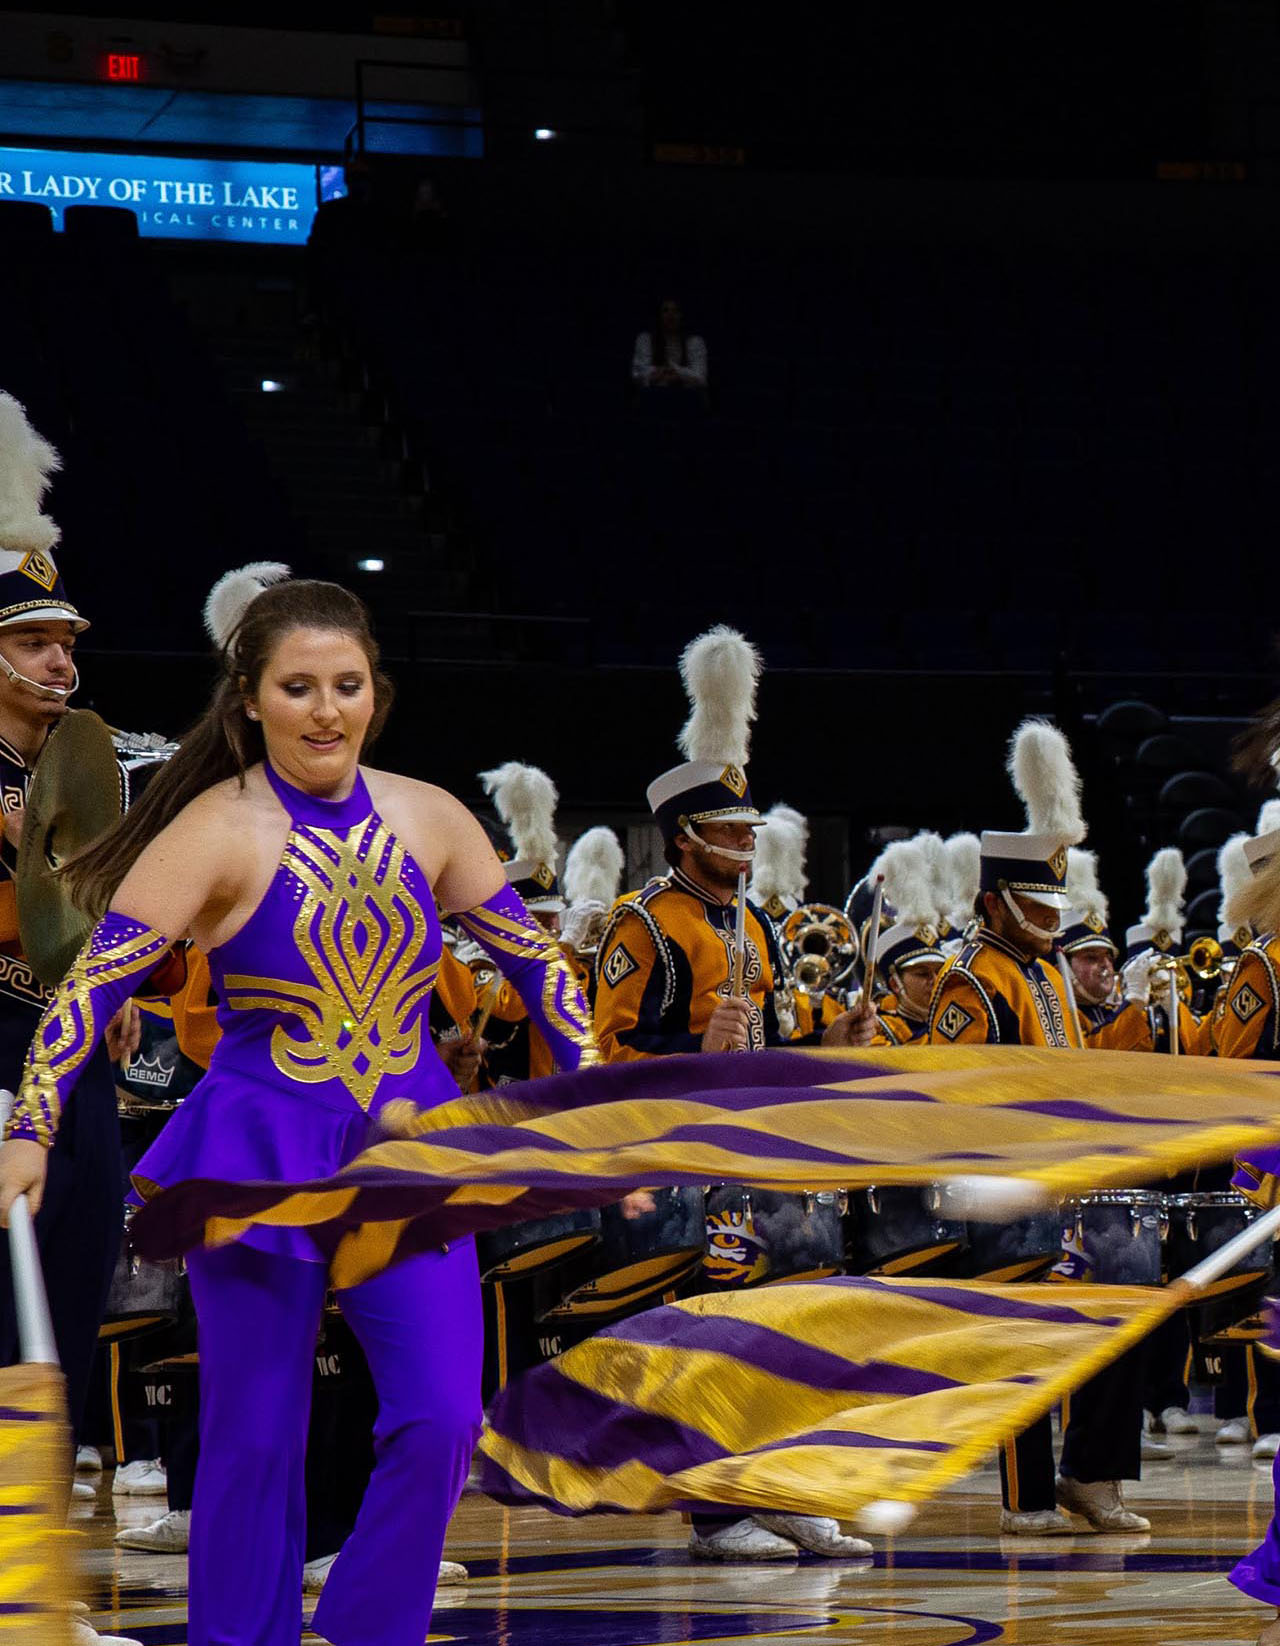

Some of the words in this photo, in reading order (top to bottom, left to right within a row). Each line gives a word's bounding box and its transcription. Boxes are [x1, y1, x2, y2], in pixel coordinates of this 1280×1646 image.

[108, 54, 139, 79] EXIT
[22, 170, 101, 200] LADY
[109, 178, 147, 202] OF
[153, 180, 214, 206] THE
[222, 182, 299, 211] LAKE
[211, 215, 299, 231] CENTER
[129, 1068, 168, 1083] REMO
